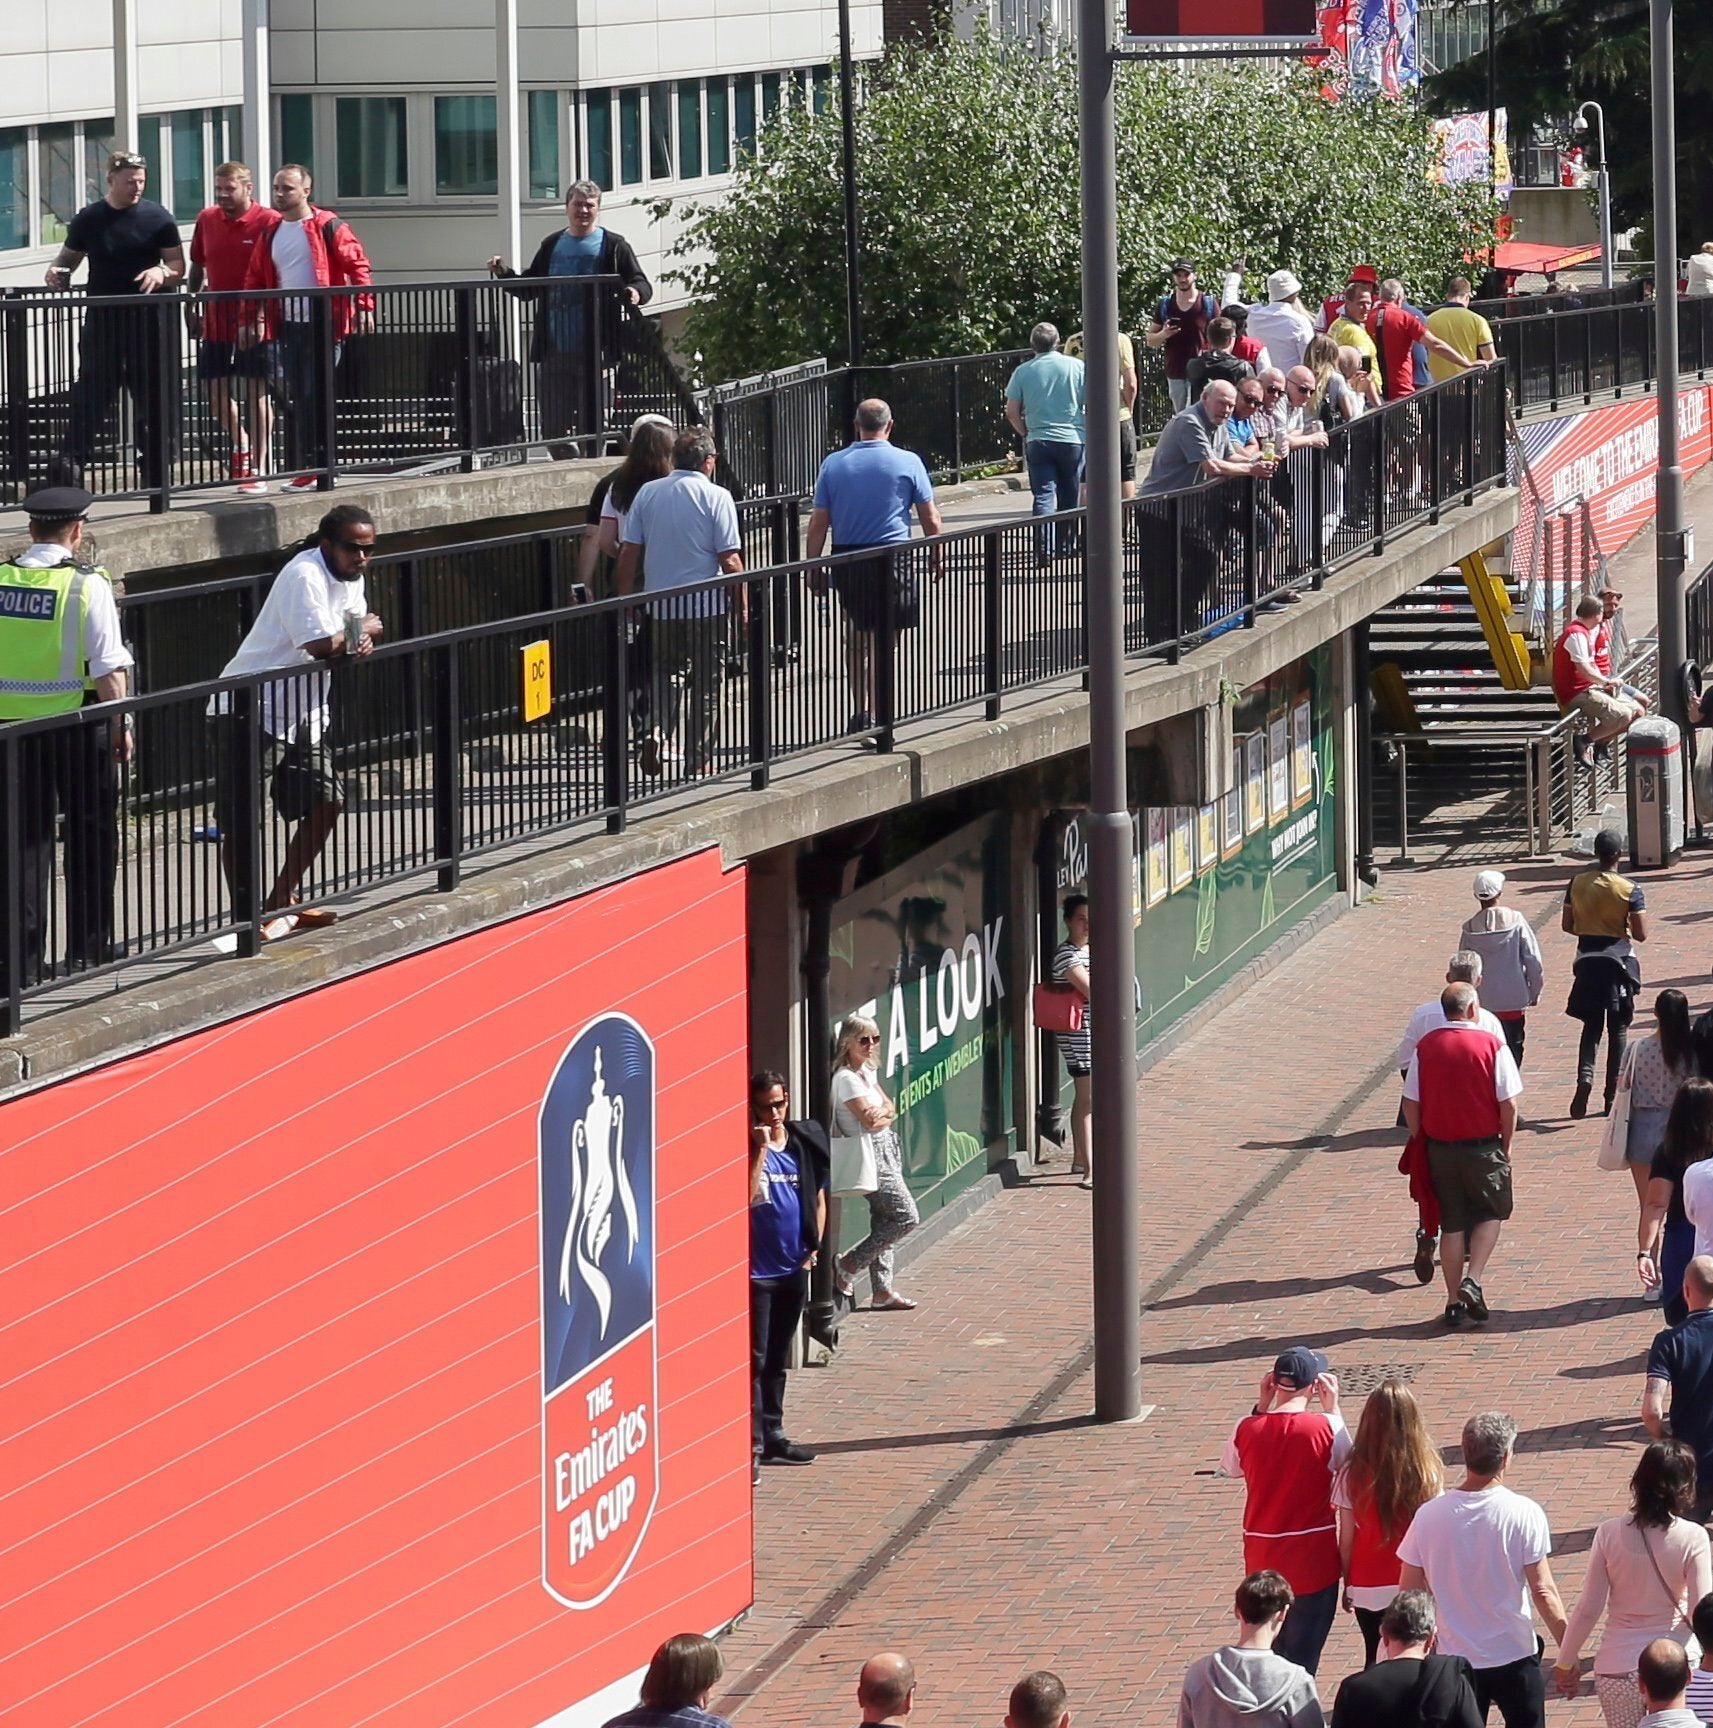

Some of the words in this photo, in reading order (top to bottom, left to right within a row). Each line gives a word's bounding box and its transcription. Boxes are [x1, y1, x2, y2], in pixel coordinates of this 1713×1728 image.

[1552, 450, 1600, 505] WELCOME
[1600, 443, 1615, 487] TO
[1635, 414, 1658, 476] EMIR
[0, 590, 53, 615] POLICE
[532, 661, 545, 682] DC
[535, 691, 541, 710] 1
[1284, 823, 1296, 851] NOT
[886, 996, 910, 1078] A
[919, 916, 1005, 1050] LOOK
[899, 1076, 932, 1114] EVENTS
[932, 1068, 944, 1094] AT
[944, 1032, 984, 1090] WEMBLEY
[586, 1377, 613, 1417] THE
[554, 1402, 648, 1512] Emirates
[568, 1505, 598, 1565] FA
[598, 1475, 636, 1544] CUP
